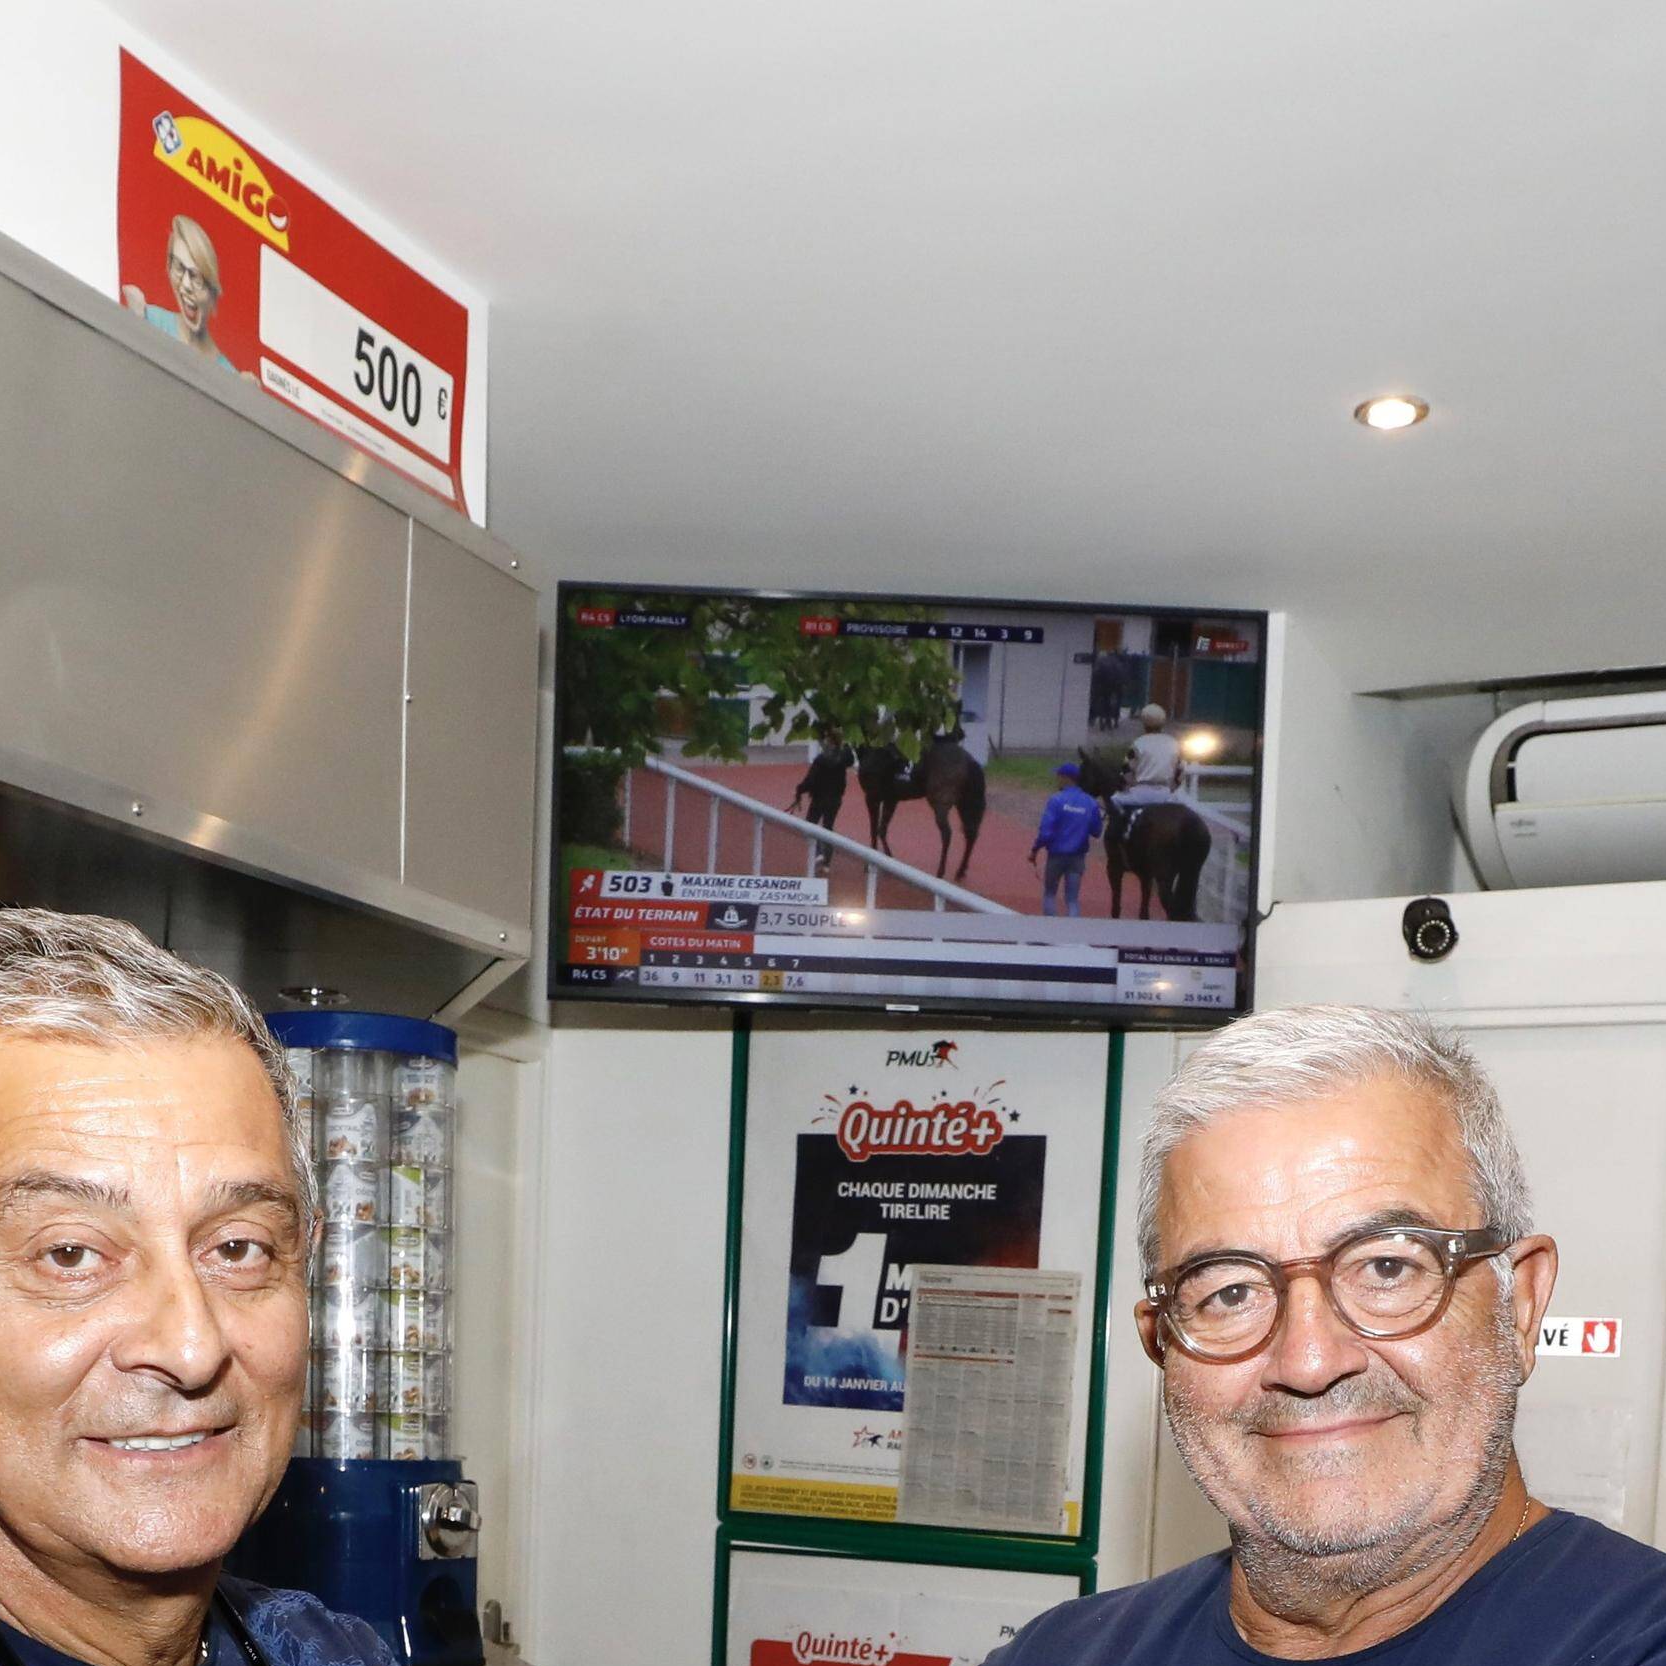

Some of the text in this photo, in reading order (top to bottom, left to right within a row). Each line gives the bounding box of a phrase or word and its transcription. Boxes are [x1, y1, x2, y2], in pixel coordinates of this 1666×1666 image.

[186, 146, 290, 232] AMIGO
[353, 327, 448, 427] 500 €
[619, 615, 687, 626] LYON-PARILLY
[846, 623, 909, 635] PROVISOIRE
[928, 626, 936, 636] 4
[951, 627, 963, 637] 12
[974, 629, 987, 638] 14
[1001, 630, 1008, 639] 3
[1024, 630, 1033, 640] 9
[609, 876, 801, 893] 503 MAXIME CESANDRI
[681, 888, 820, 903] ENTRAÎNEUR ZASYMOKA
[574, 901, 699, 922] ÉTAT DU TERRAIN
[759, 912, 782, 927] 3,7
[649, 935, 685, 947] COTES
[688, 937, 703, 948] DU
[705, 938, 741, 949] MATIN
[649, 954, 655, 964] 1
[672, 955, 680, 964] 2
[696, 955, 704, 965] 3
[720, 956, 728, 965] 4
[744, 957, 751, 966] 5
[792, 959, 800, 968] 7
[573, 970, 589, 980] R4
[644, 971, 659, 982] 36
[671, 972, 680, 982] 9
[694, 973, 705, 983] 11
[715, 974, 732, 985] 3,1
[742, 974, 754, 985] 12
[787, 976, 804, 988] 7,6
[885, 1050, 928, 1067] PMU
[844, 1106, 996, 1153] Quinté+
[837, 1182, 998, 1200] CHAQUE DIMANCHE
[880, 1203, 951, 1220] TIRELIRE
[816, 1232, 888, 1329] 1
[1543, 1324, 1570, 1347] VÉ
[804, 1376, 820, 1388] DU
[824, 1377, 836, 1389] 14
[839, 1378, 888, 1392] JANVIER
[797, 1630, 889, 1662] Quinté+
